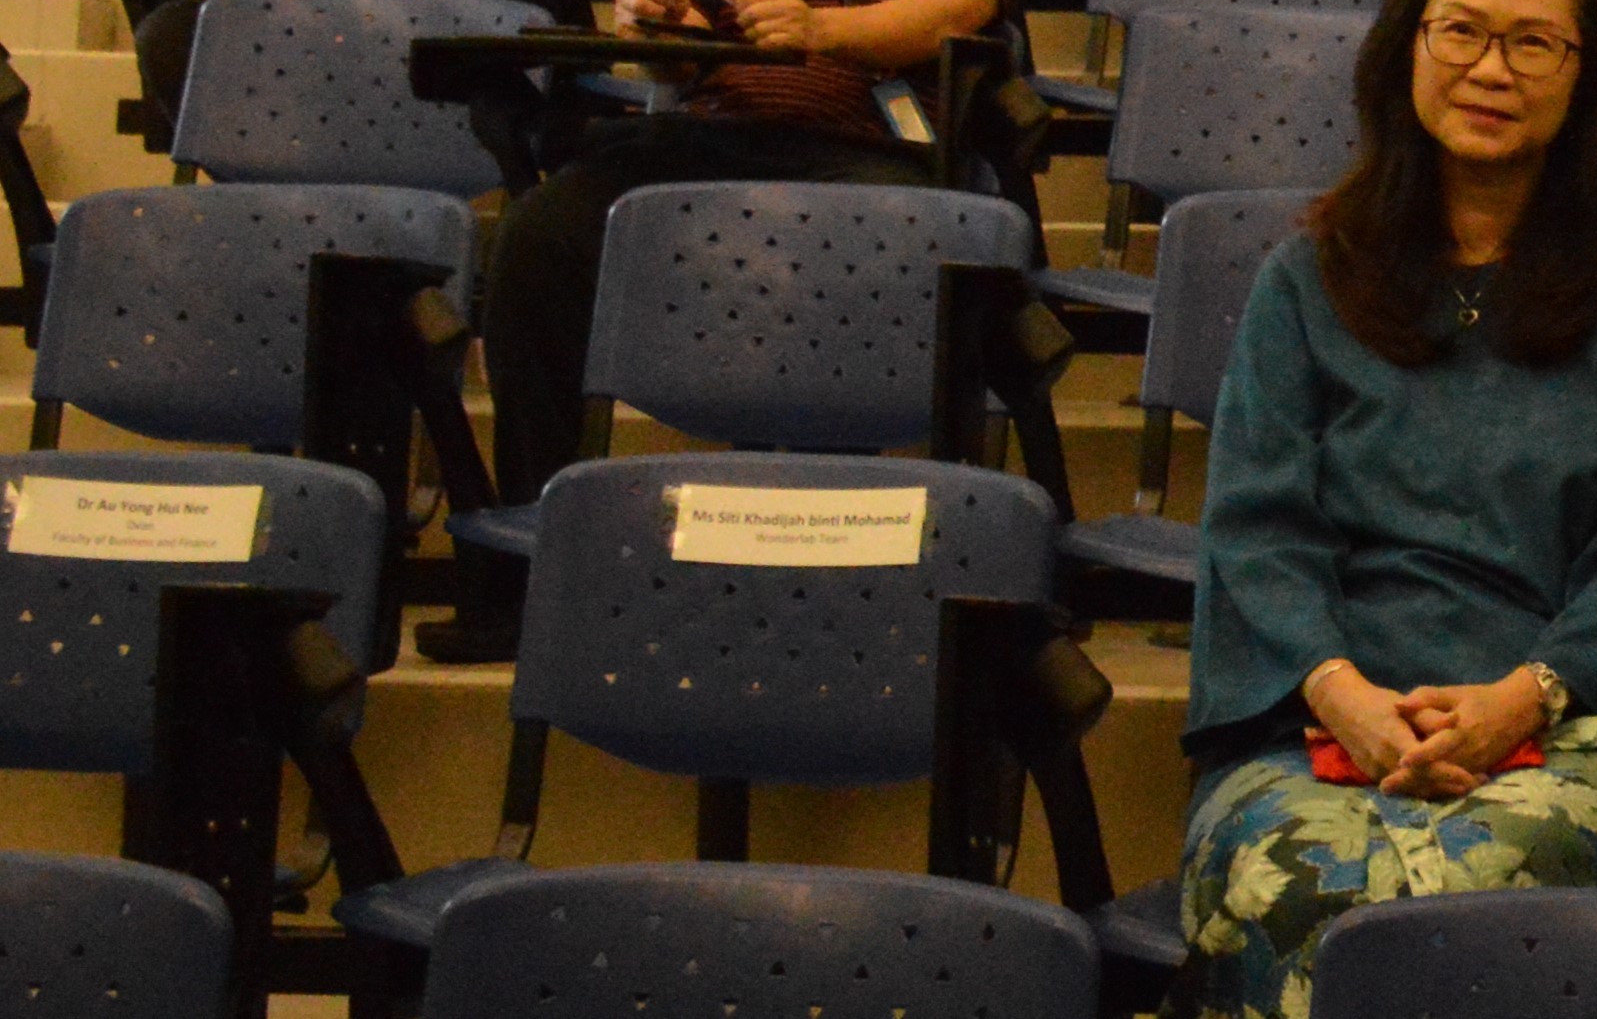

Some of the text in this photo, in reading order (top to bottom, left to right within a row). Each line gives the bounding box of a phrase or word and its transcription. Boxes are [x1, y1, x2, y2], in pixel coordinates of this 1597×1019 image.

[78, 497, 209, 516] Dr Au Yong Hui Nee
[692, 510, 911, 529] Ms Siti Khadijah binti Mohamad
[52, 531, 91, 545] Faculty
[94, 535, 106, 545] of
[108, 536, 154, 547] Business
[179, 538, 217, 549] Finance
